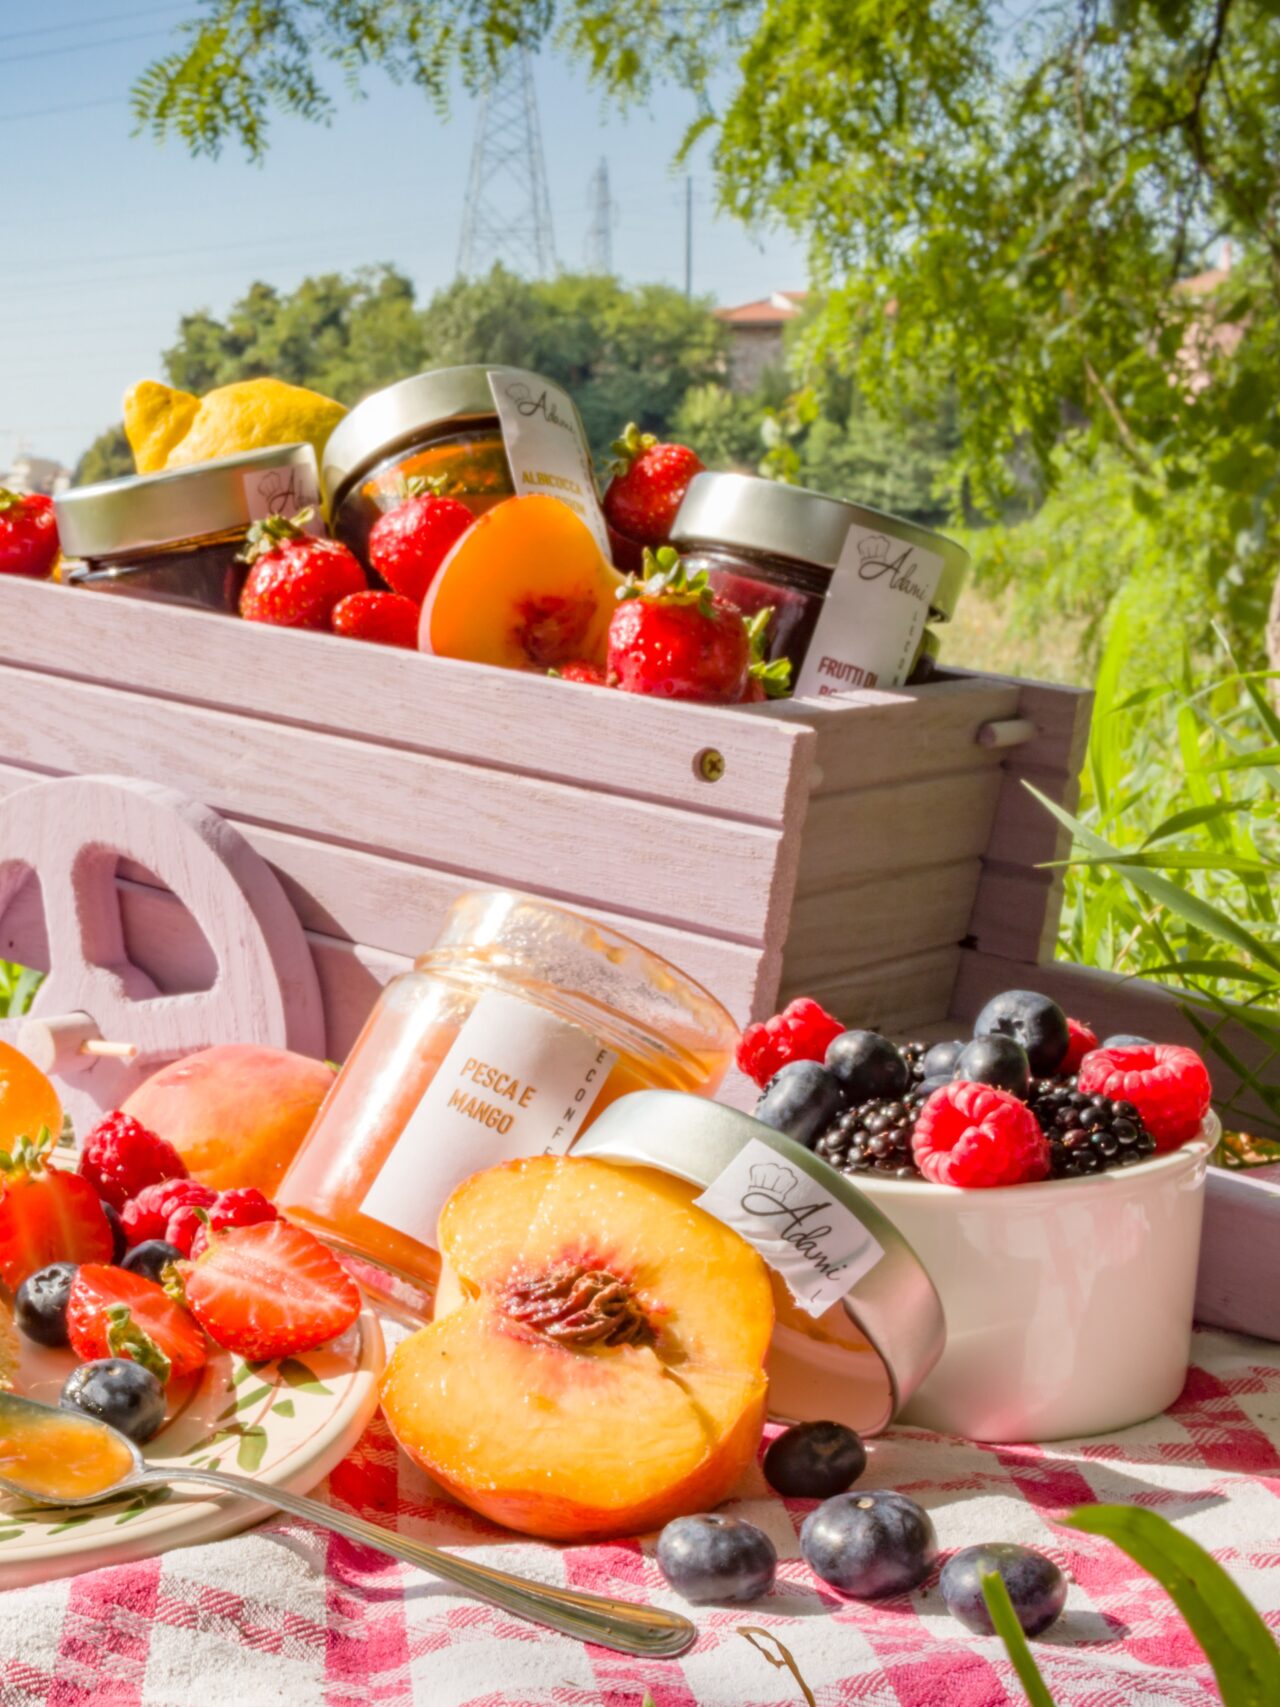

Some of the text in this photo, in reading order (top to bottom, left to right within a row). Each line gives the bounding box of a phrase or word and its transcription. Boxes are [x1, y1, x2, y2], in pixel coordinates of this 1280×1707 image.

[858, 547, 930, 602] Adami
[817, 656, 879, 688] FRUTTI DI
[460, 1057, 537, 1109] PESCA E
[446, 1088, 516, 1136] MANGO
[741, 1191, 848, 1281] Adami
